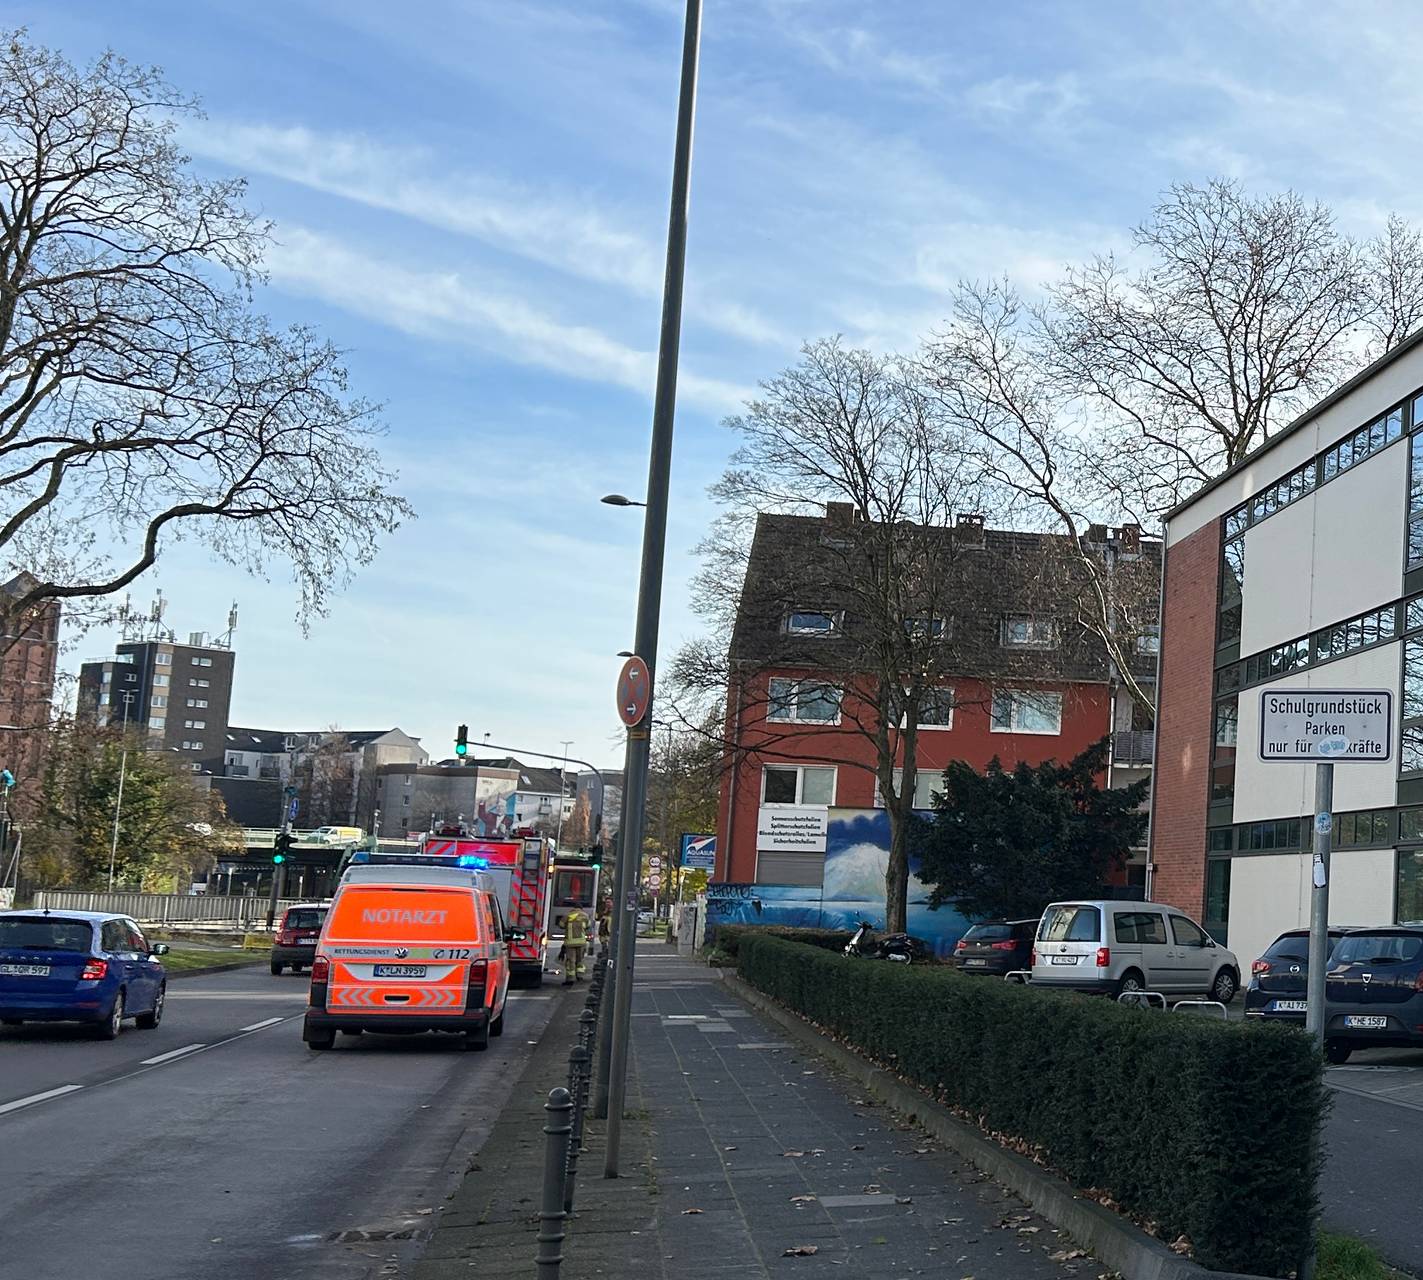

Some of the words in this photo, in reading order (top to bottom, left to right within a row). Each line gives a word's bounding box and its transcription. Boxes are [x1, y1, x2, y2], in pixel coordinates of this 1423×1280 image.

[1269, 697, 1383, 718] Schulgrundstück
[1305, 721, 1346, 735] Parken
[1268, 742, 1289, 753] nur
[1295, 739, 1313, 753] für
[362, 908, 448, 925] NOTARZT
[334, 948, 390, 956] RETTUNGSDIENST
[448, 949, 470, 959] 112
